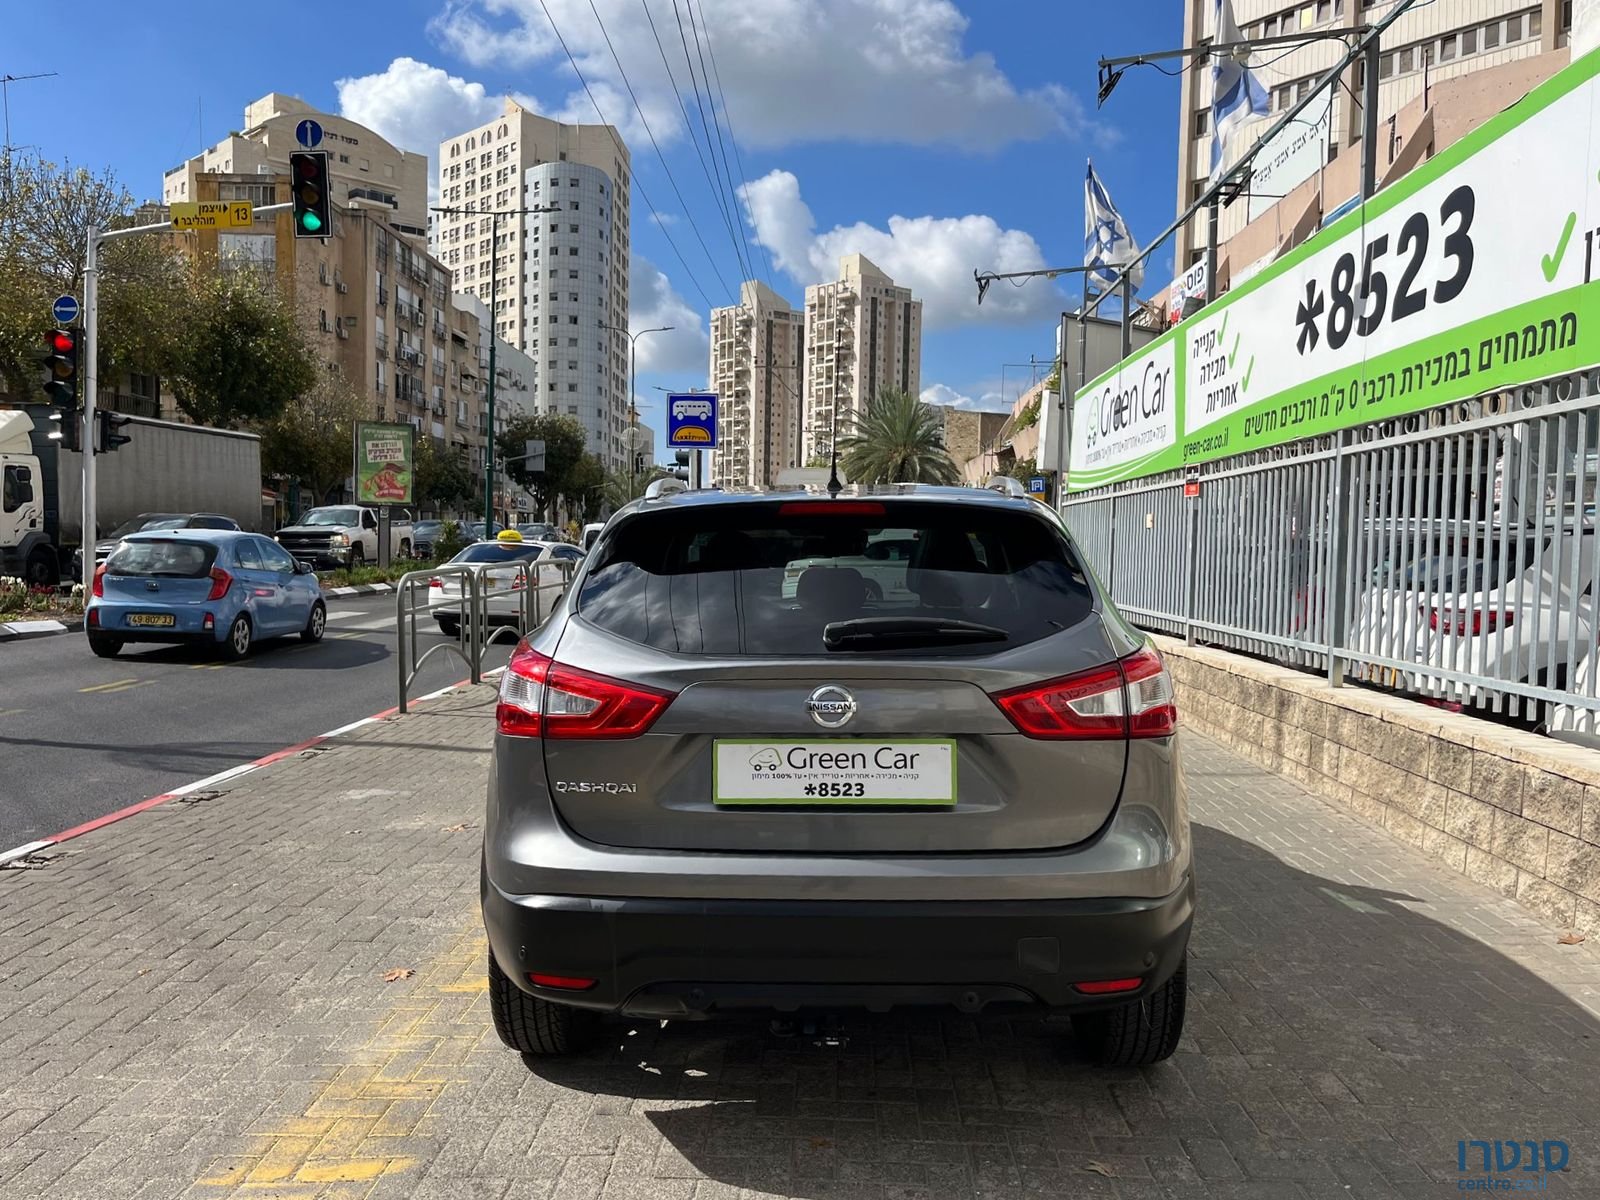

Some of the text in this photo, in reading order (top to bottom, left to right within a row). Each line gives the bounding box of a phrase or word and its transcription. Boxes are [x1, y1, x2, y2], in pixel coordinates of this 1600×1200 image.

[181, 214, 216, 226] מוהליבר
[199, 204, 222, 216] ויצמן
[234, 208, 248, 220] 13
[1186, 261, 1207, 291] פוס
[1193, 329, 1216, 359] קנייה
[1478, 312, 1577, 372] מתמחים
[1200, 355, 1226, 386] מכירה
[1400, 348, 1470, 396] במכירת
[1100, 361, 1171, 438] Green Car
[1206, 382, 1239, 414] אחריות
[1350, 379, 1359, 409] 0
[1363, 372, 1395, 405] רכבי
[1244, 409, 1278, 437] חדשים
[1280, 397, 1317, 428] ורכבים
[1183, 426, 1229, 462] green-car.co.il
[812, 703, 852, 711] NISSAN
[787, 746, 920, 769] Green Car
[556, 781, 637, 795] QASHQAI
[903, 773, 919, 781] קניה
